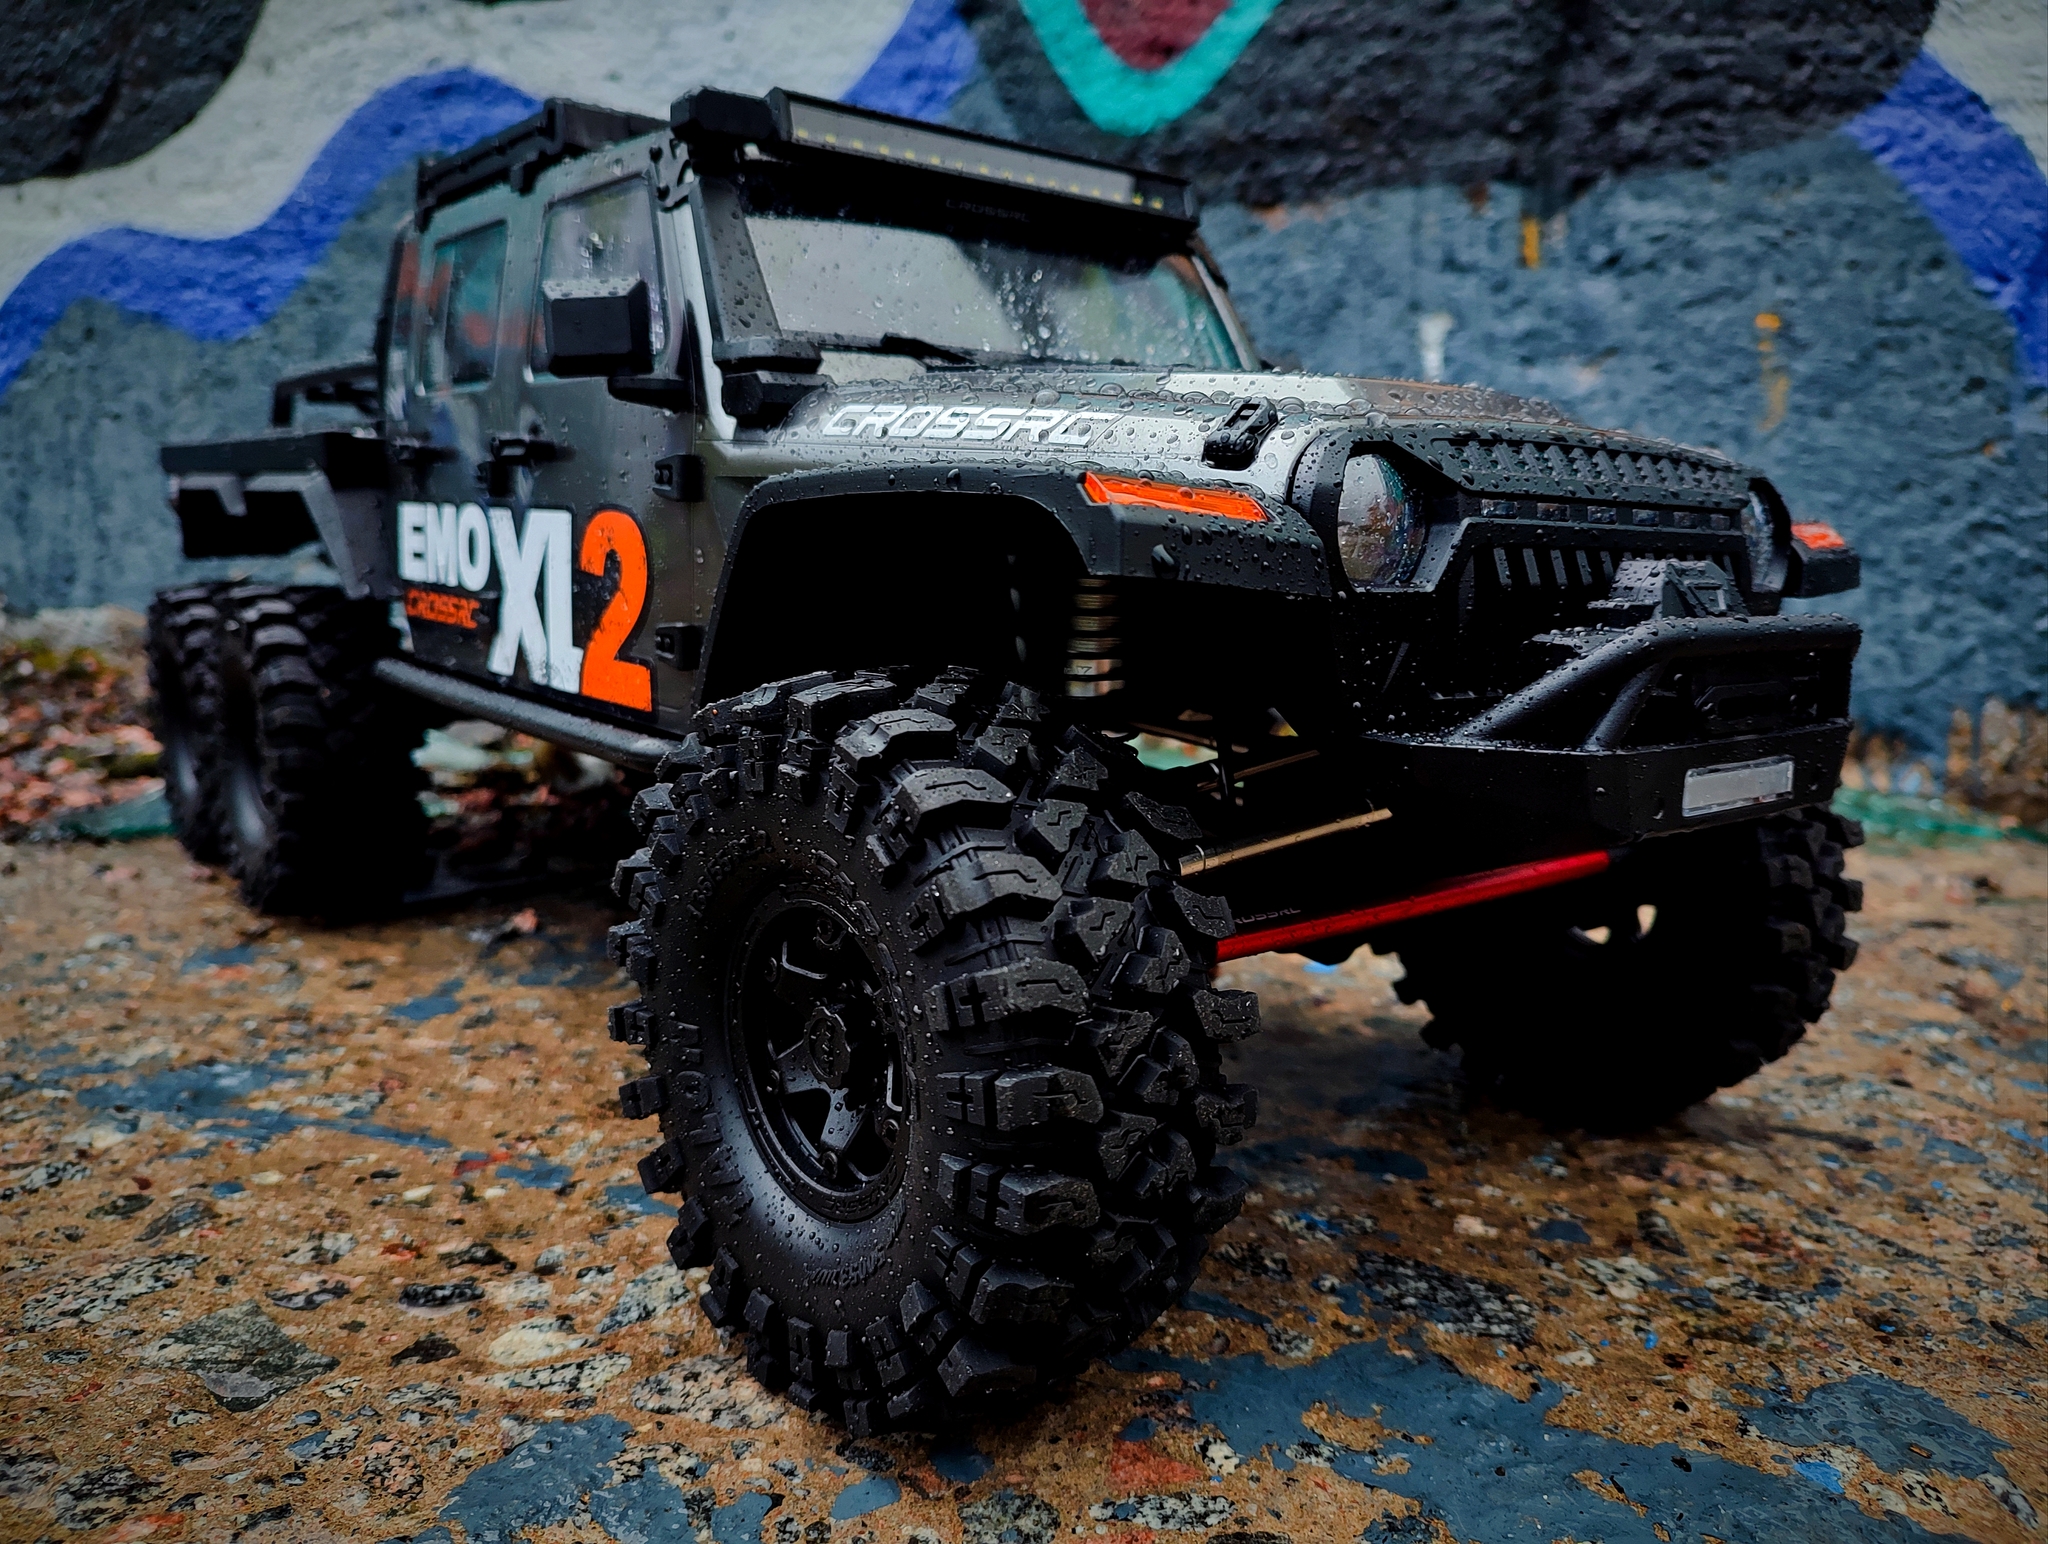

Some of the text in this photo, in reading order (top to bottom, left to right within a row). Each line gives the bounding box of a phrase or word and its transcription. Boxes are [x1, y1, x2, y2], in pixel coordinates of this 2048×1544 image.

[822, 404, 1119, 446] CROSSRC
[397, 501, 491, 592] EMO
[405, 588, 480, 630] CROSSRC
